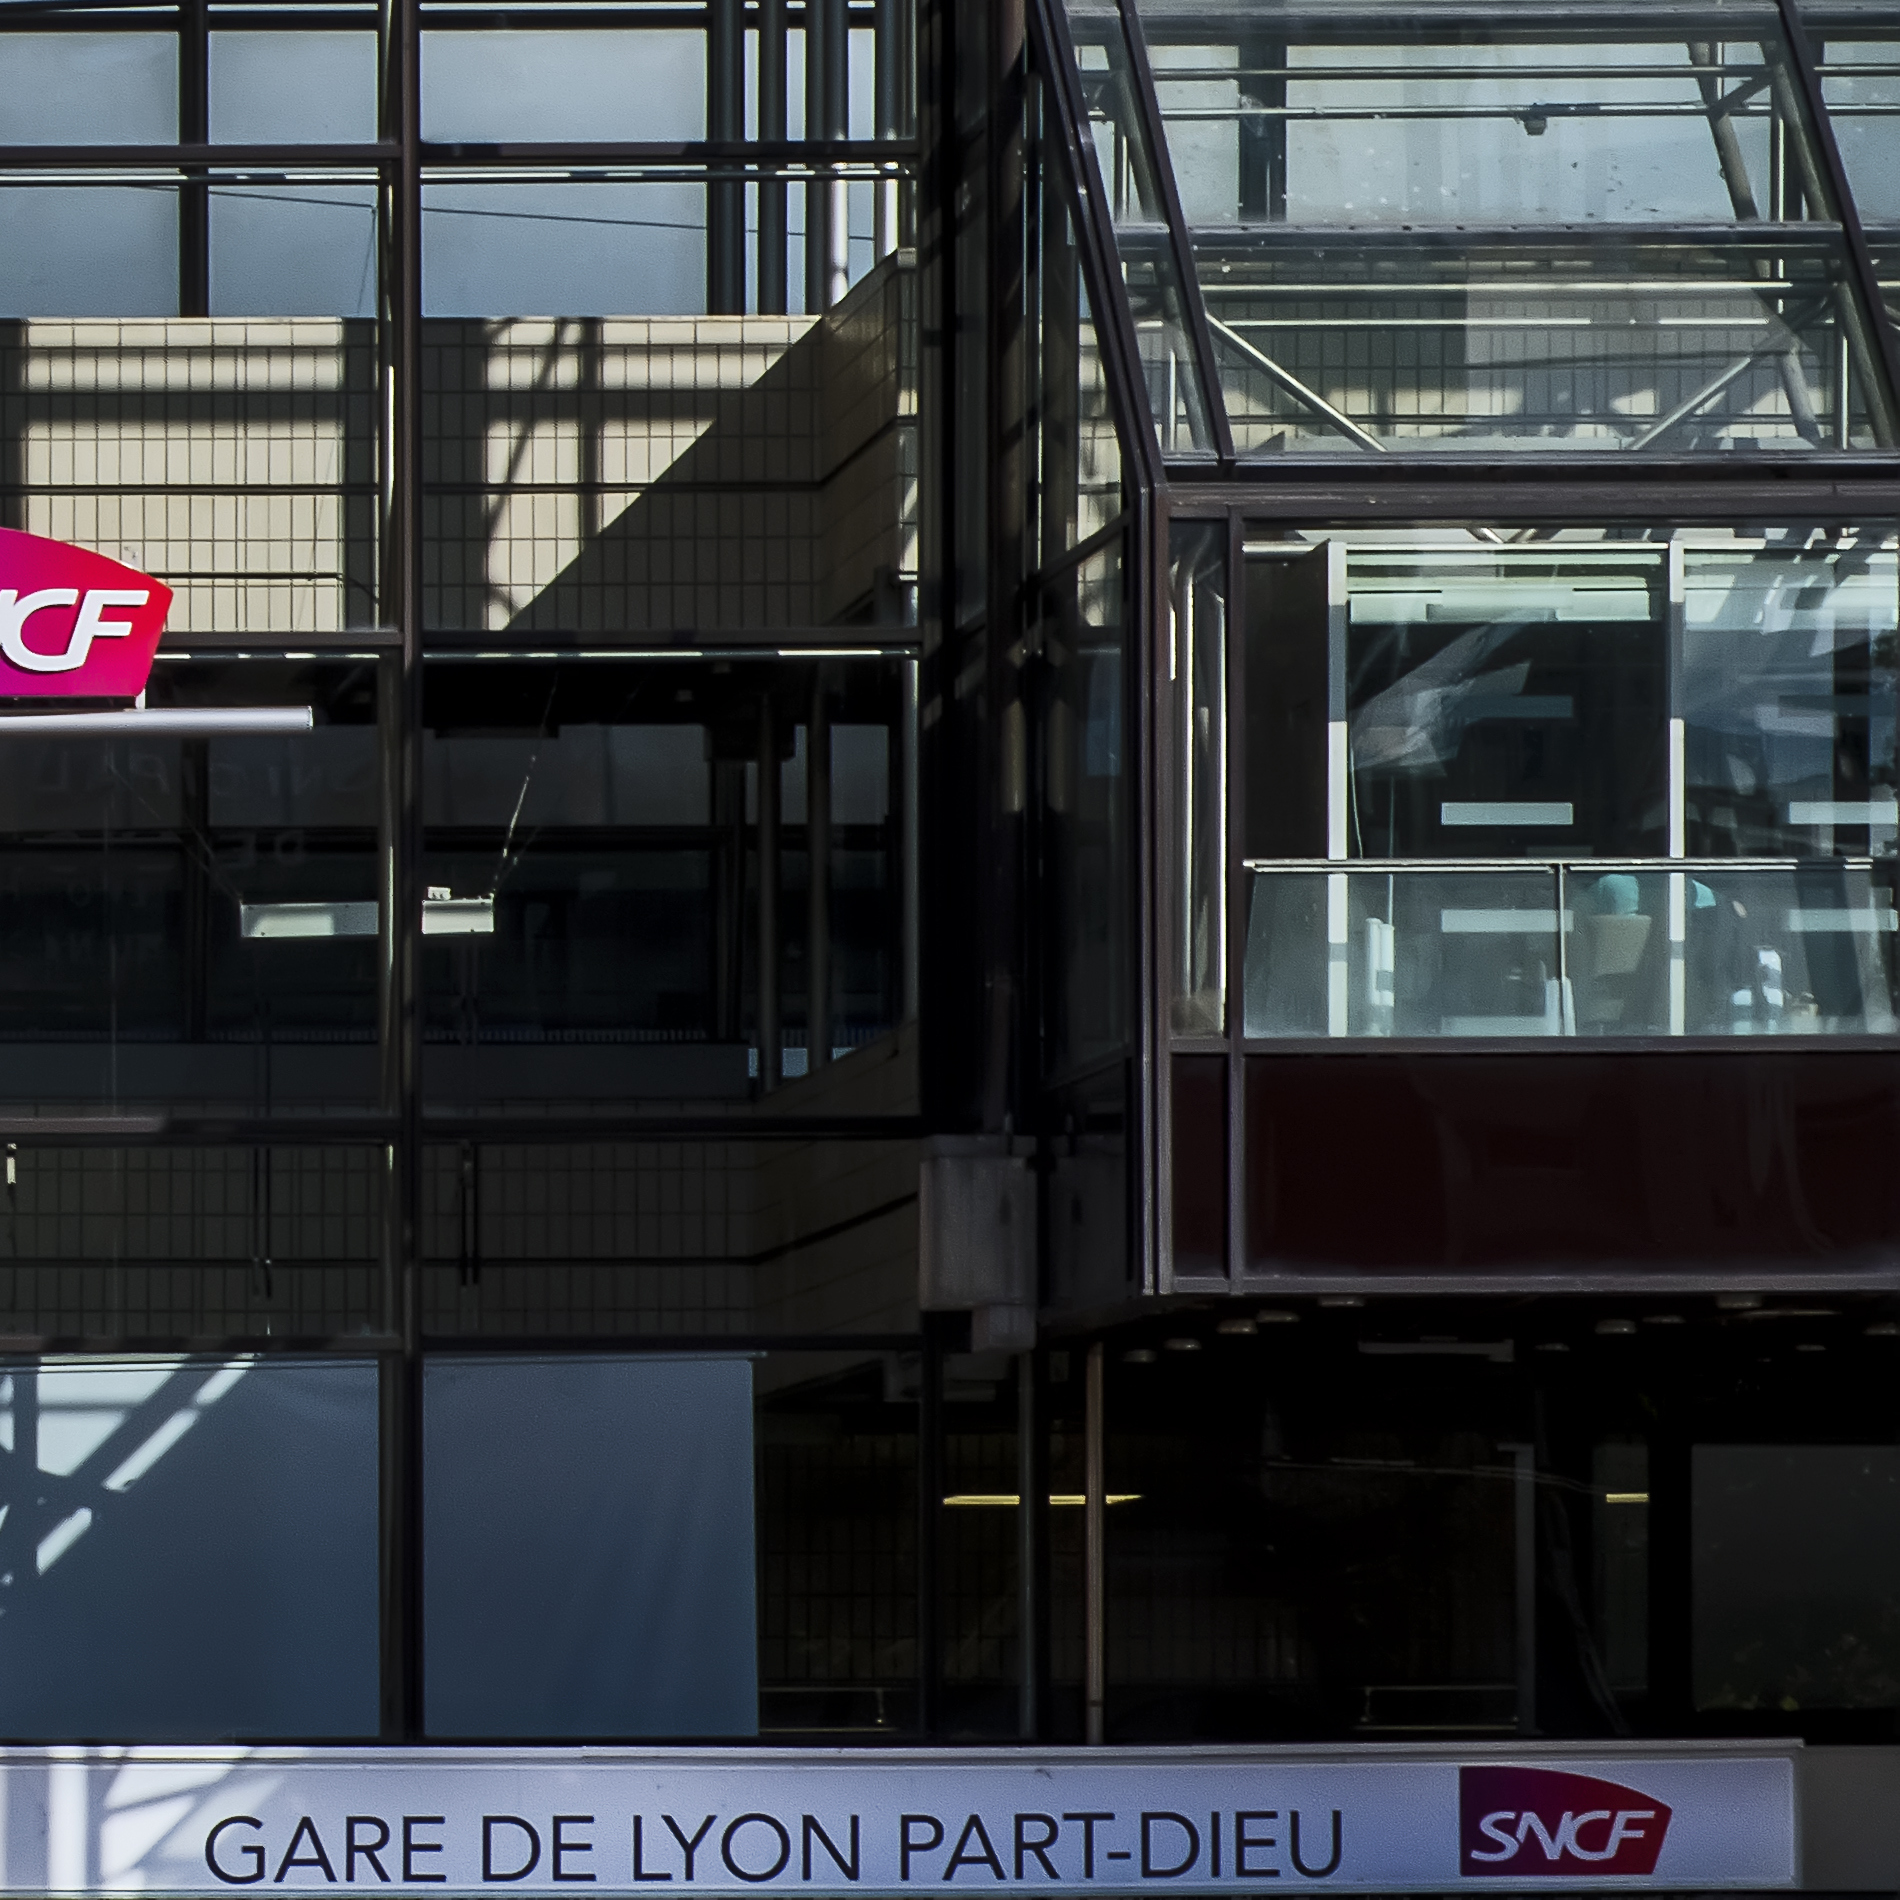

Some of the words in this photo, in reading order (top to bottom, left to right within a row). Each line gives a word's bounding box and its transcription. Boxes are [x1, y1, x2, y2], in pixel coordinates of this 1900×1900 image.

[203, 1814, 447, 1884] GARE
[481, 1814, 597, 1882] DE
[632, 1812, 860, 1883] LYON
[899, 1808, 1343, 1881] PART-DIEU
[1468, 1808, 1657, 1864] SNCF
